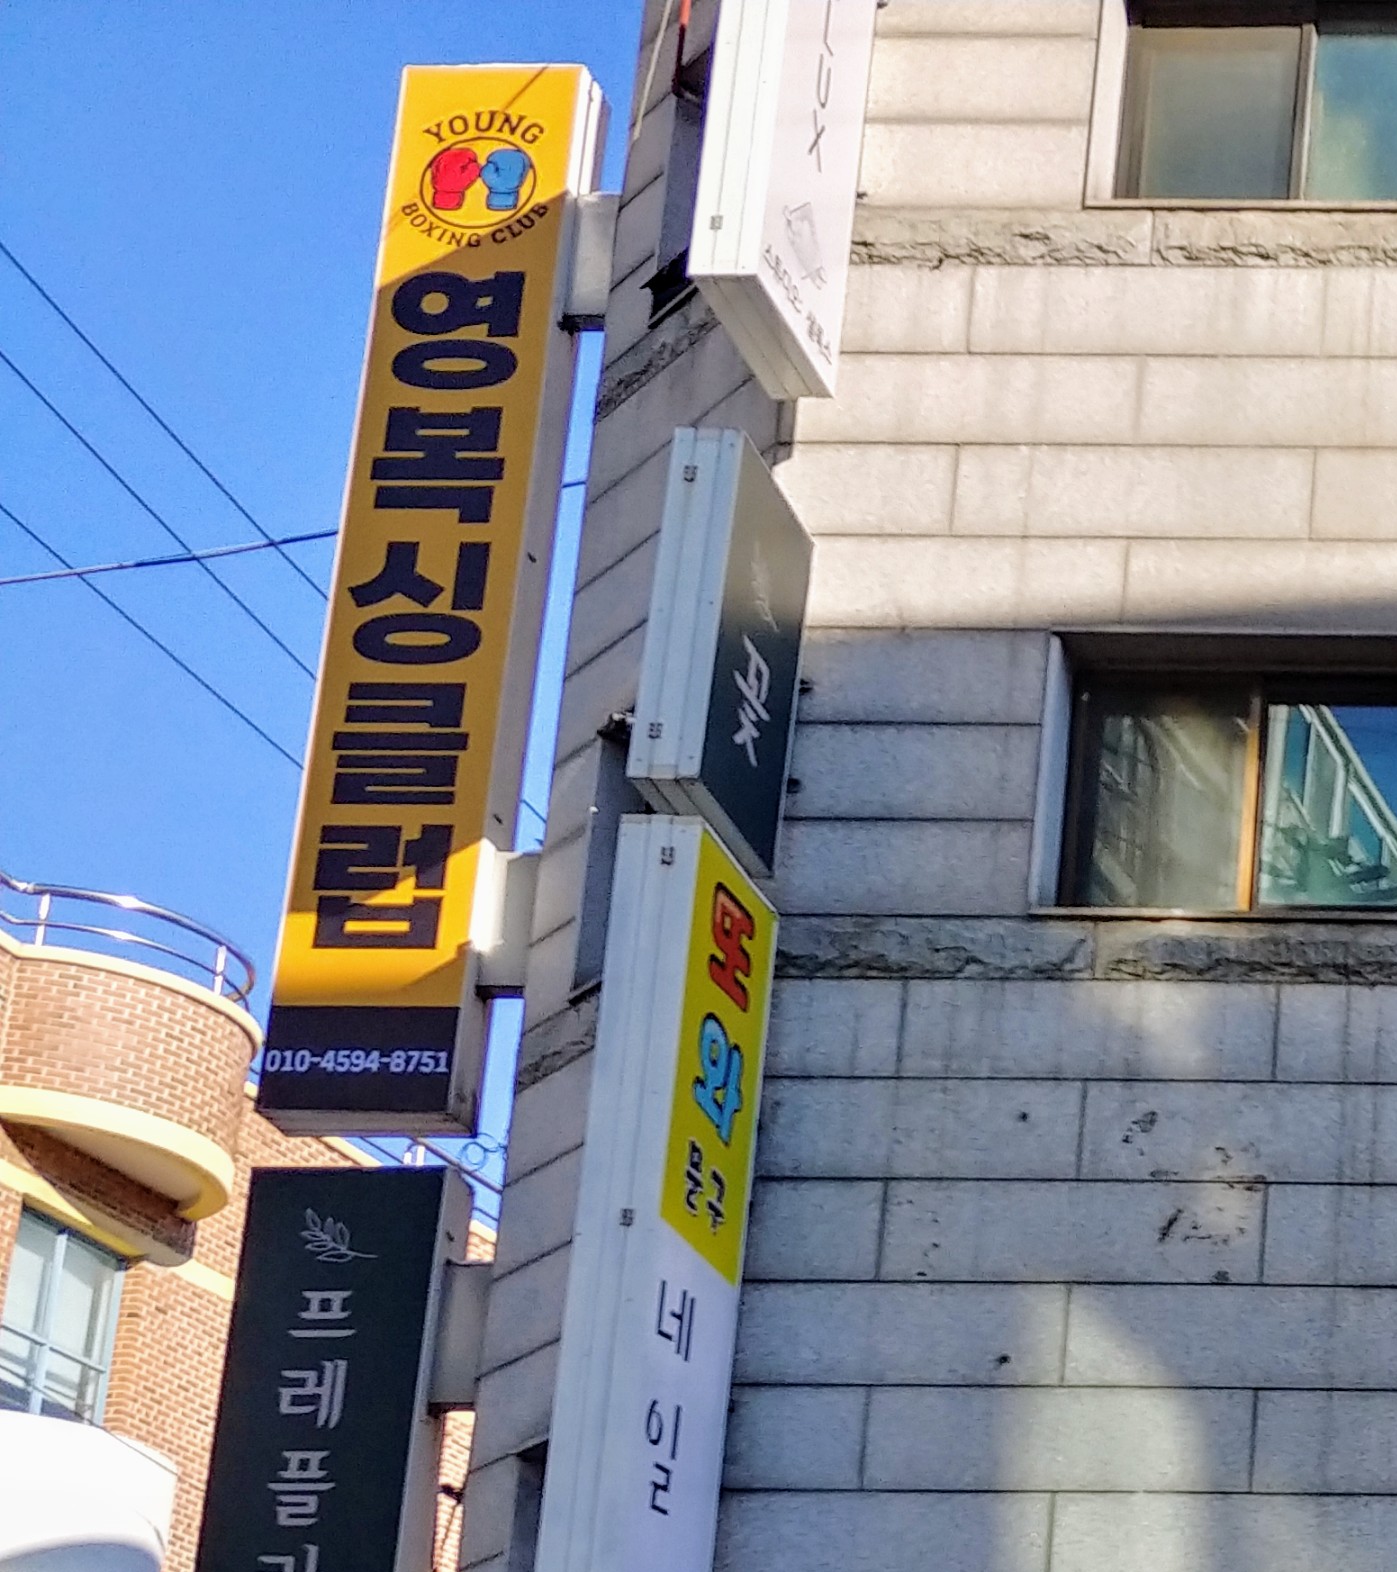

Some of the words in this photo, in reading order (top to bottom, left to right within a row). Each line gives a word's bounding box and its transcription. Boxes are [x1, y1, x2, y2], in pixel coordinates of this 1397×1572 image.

[423, 110, 546, 147] YOUNG
[400, 201, 482, 249] BOXING
[491, 201, 550, 246] CLUB
[313, 270, 527, 952] 영복싱클럽
[692, 881, 756, 1147] 또와
[265, 1044, 449, 1078] 010-4594-8751
